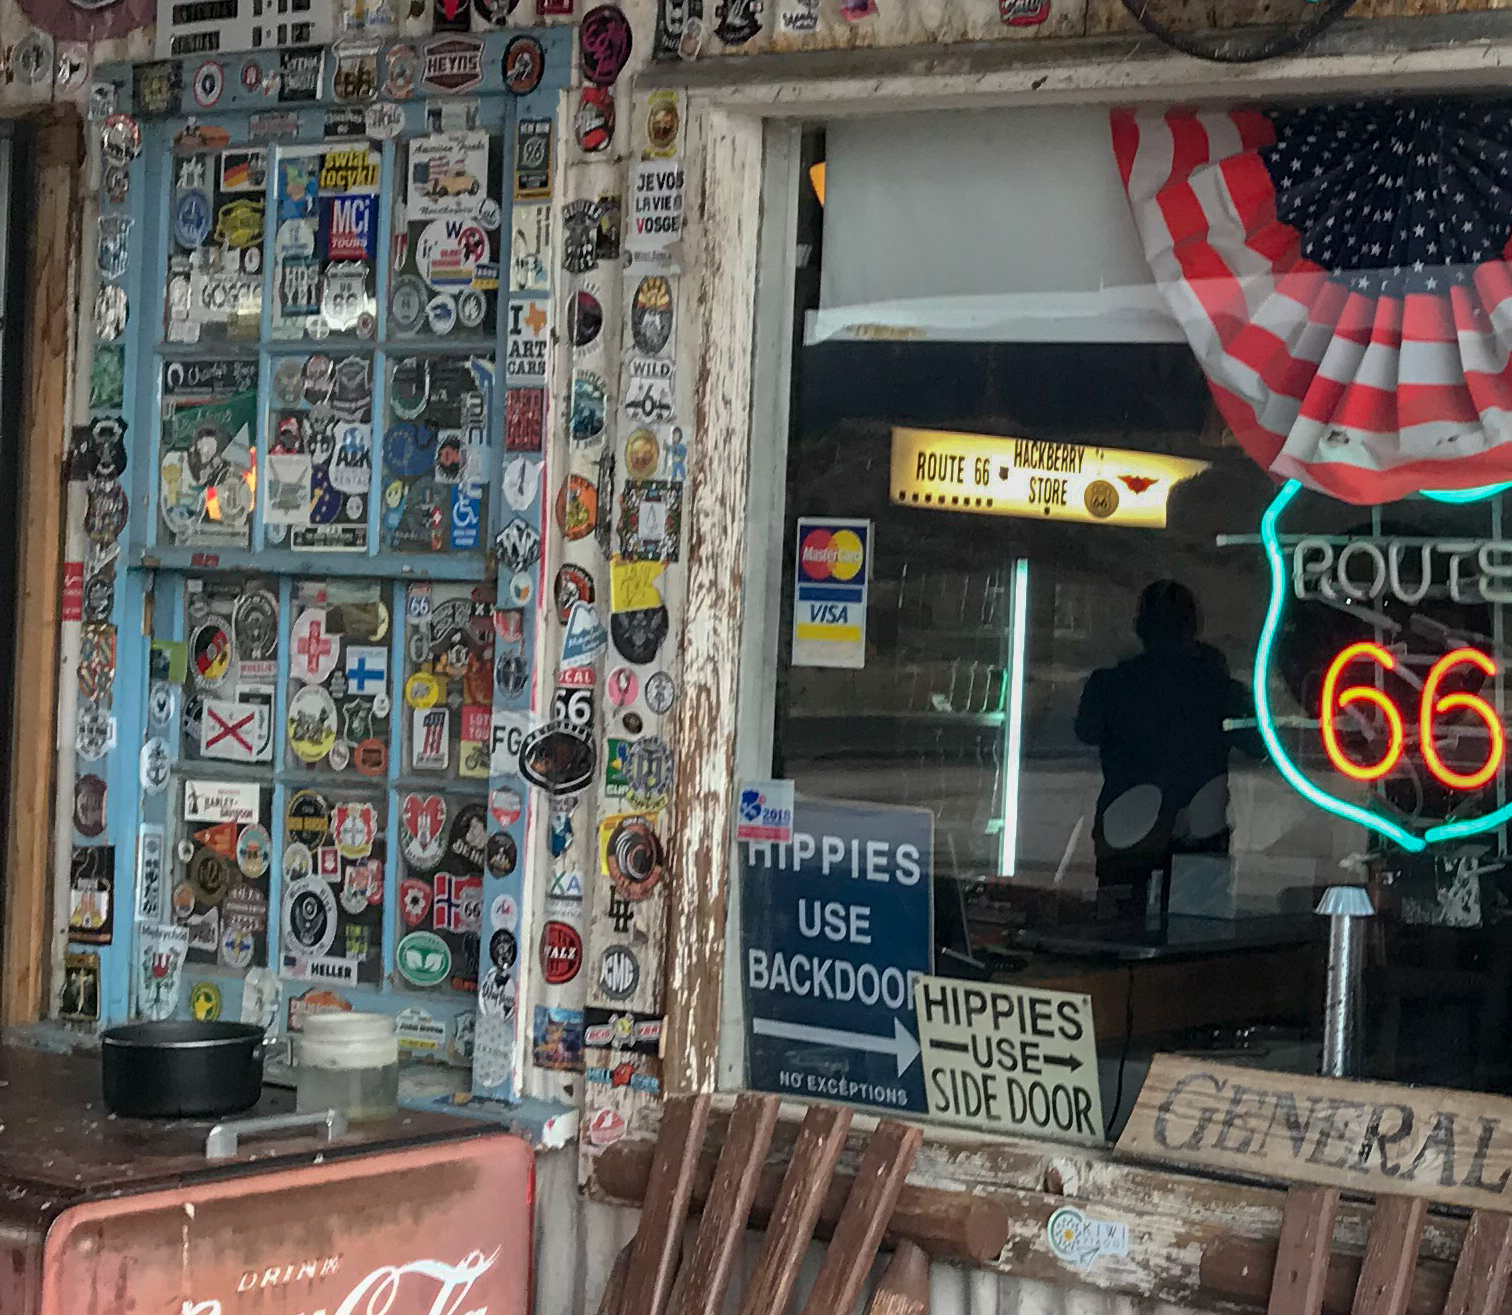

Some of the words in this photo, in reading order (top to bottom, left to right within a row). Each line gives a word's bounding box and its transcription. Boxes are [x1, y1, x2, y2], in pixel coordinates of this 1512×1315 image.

[636, 172, 654, 192] JE
[636, 215, 682, 235] VOSGE
[331, 237, 368, 251] TOURS
[508, 340, 548, 358] ART
[506, 360, 547, 376] CARS
[630, 361, 672, 378] WILD
[916, 450, 966, 484] ROUTE
[973, 455, 991, 487] 66
[1013, 438, 1086, 475] HACKBERRY
[1028, 476, 1069, 507] STORE
[801, 544, 864, 564] MasterCard
[409, 596, 429, 614] 66
[807, 603, 849, 625] VISA
[556, 668, 594, 685] OCAL
[553, 690, 593, 726] 66
[1319, 639, 1508, 791] 66
[748, 831, 923, 887] HIPPIES
[798, 897, 873, 945] USE
[310, 961, 353, 979] HELLER
[922, 984, 1084, 1043] HIPPIES
[971, 1036, 1042, 1075] USE
[779, 1070, 804, 1088] NO
[806, 1072, 909, 1107] EXCEPTIONS
[931, 1065, 999, 1119] SIDE
[1006, 1075, 1096, 1138] DOOR
[1153, 1070, 1512, 1198] GENERAL
[1083, 1222, 1127, 1240] KIWI
[235, 1253, 345, 1293] DRINK
